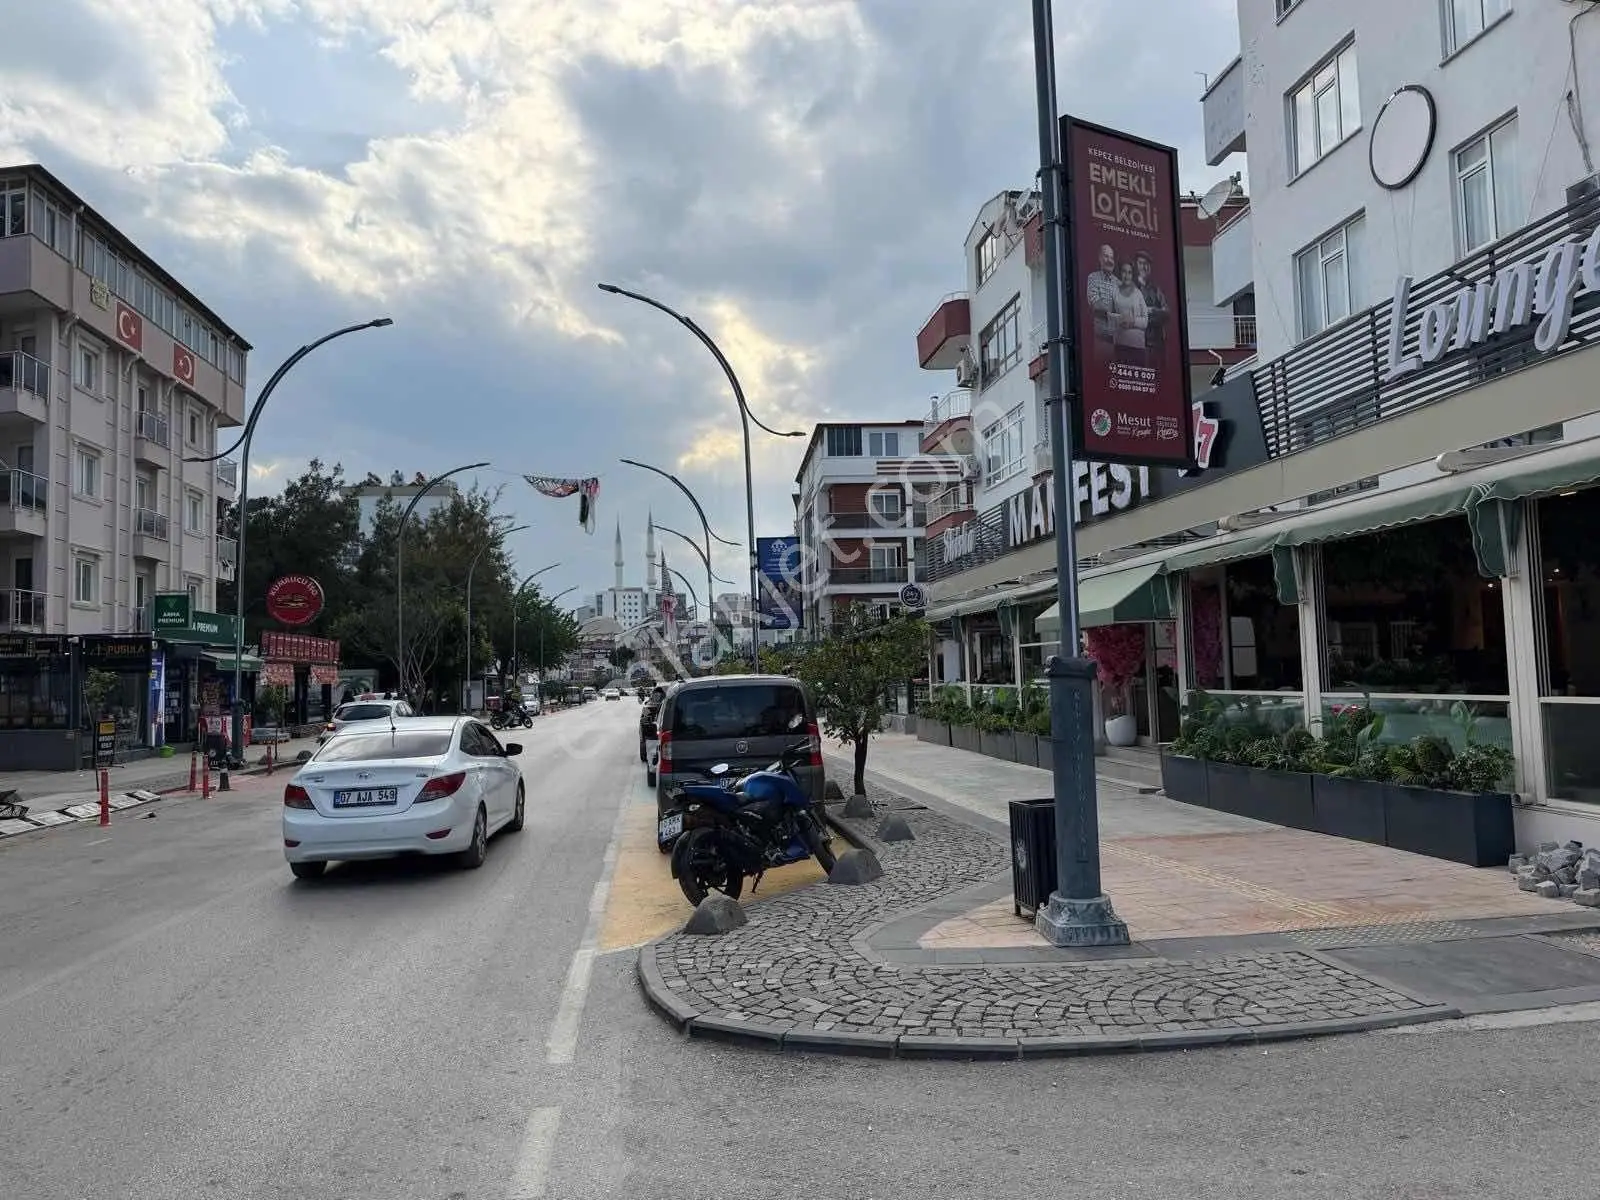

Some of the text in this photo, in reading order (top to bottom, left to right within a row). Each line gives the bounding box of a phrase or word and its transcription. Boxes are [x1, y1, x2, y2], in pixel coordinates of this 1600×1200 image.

[1088, 147, 1113, 161] KEPEZ
[1089, 162, 1157, 198] EMEKLİ
[1117, 412, 1151, 427] Mesut
[340, 789, 395, 801] 07 AJA 549
